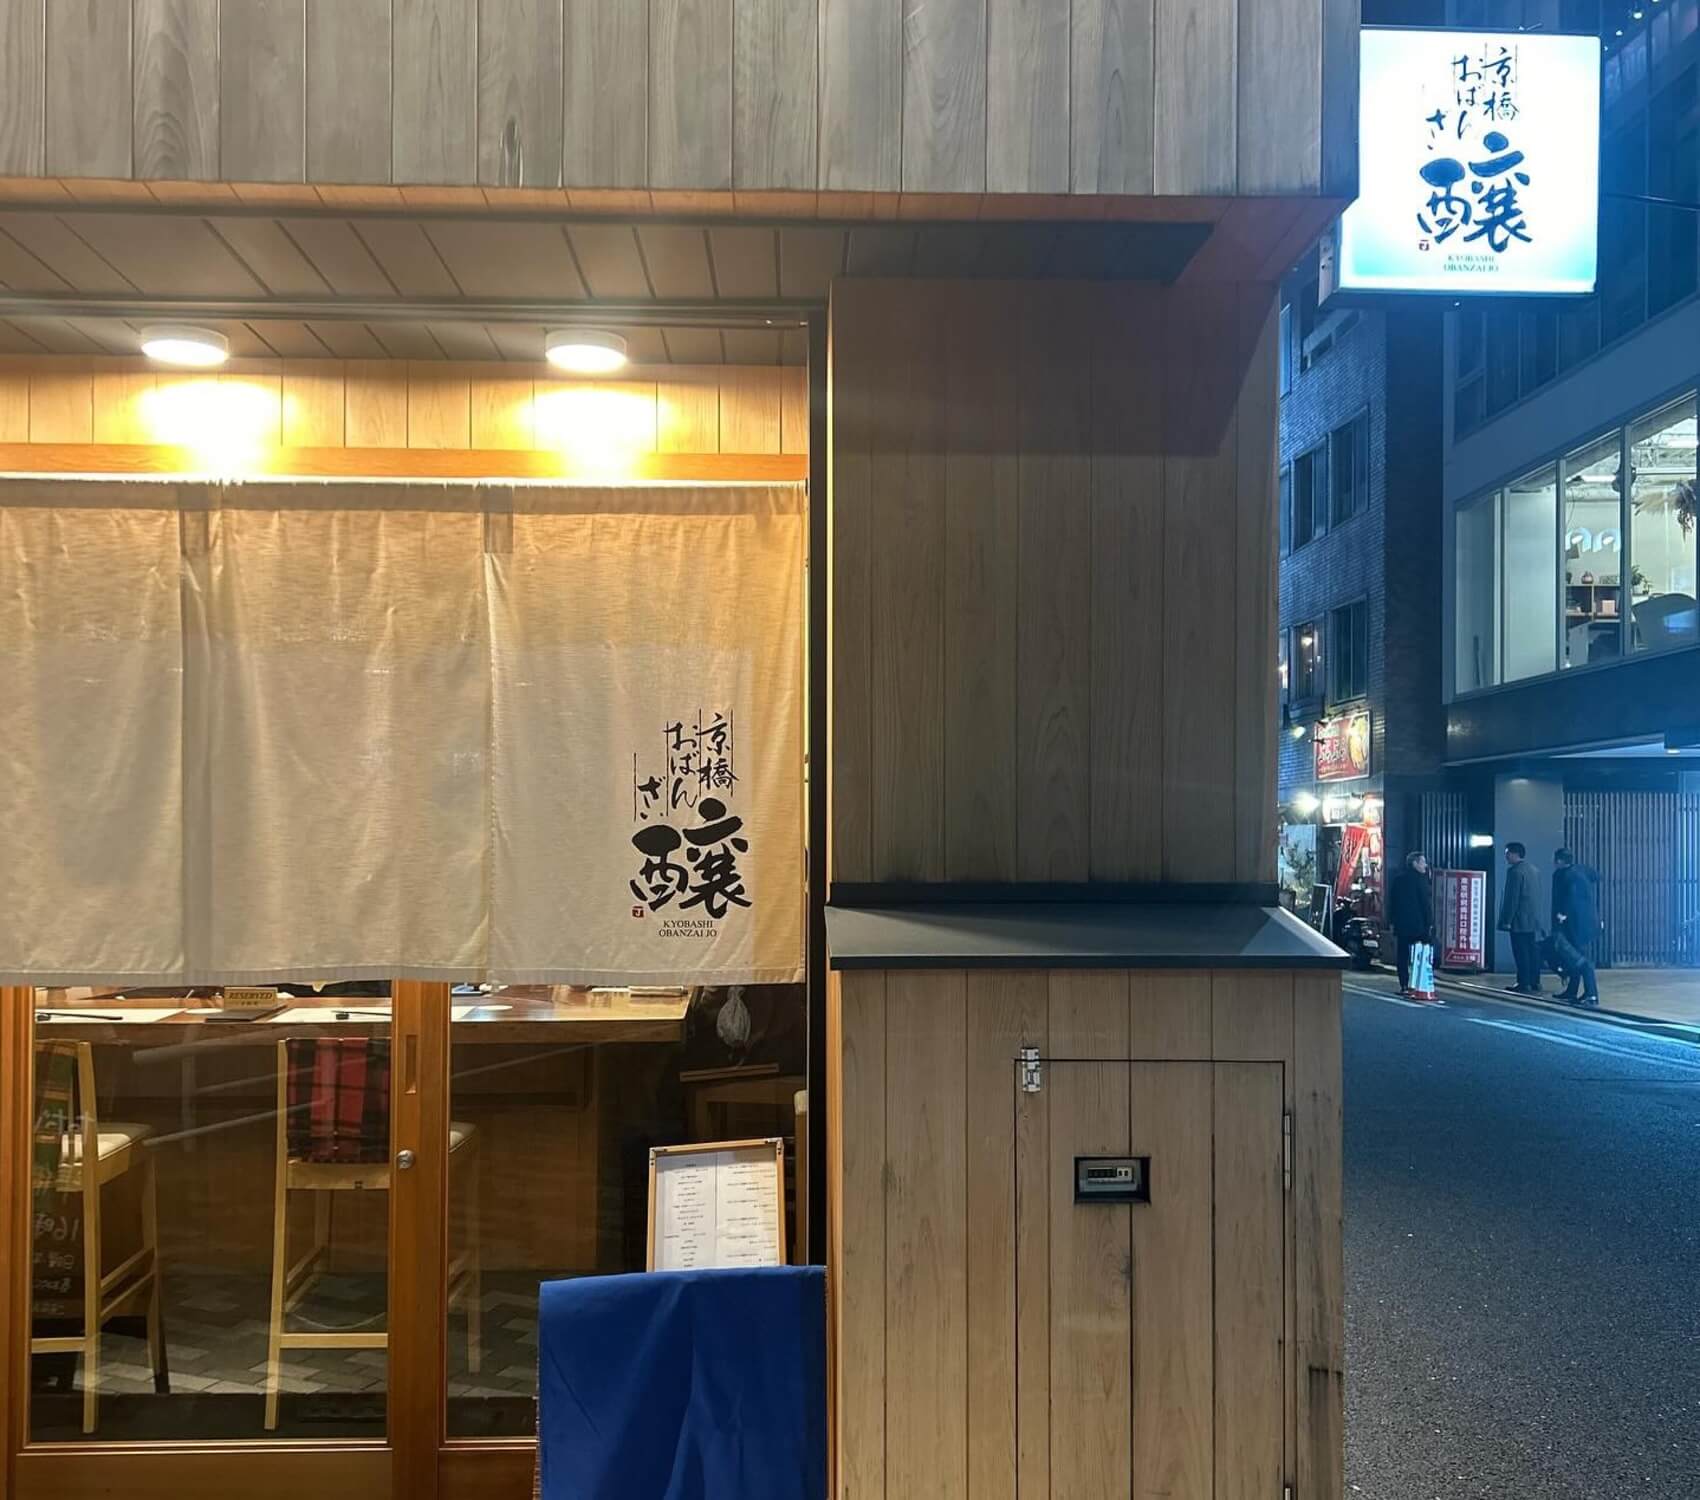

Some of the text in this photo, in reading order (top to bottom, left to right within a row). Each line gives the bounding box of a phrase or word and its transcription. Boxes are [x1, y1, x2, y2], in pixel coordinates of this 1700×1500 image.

[1483, 47, 1520, 122] 京橋
[695, 711, 739, 790] 京橋
[663, 920, 713, 928] KYOBASHI
[658, 929, 718, 937] OBANZAI JO
[228, 991, 273, 999] RESERVED
